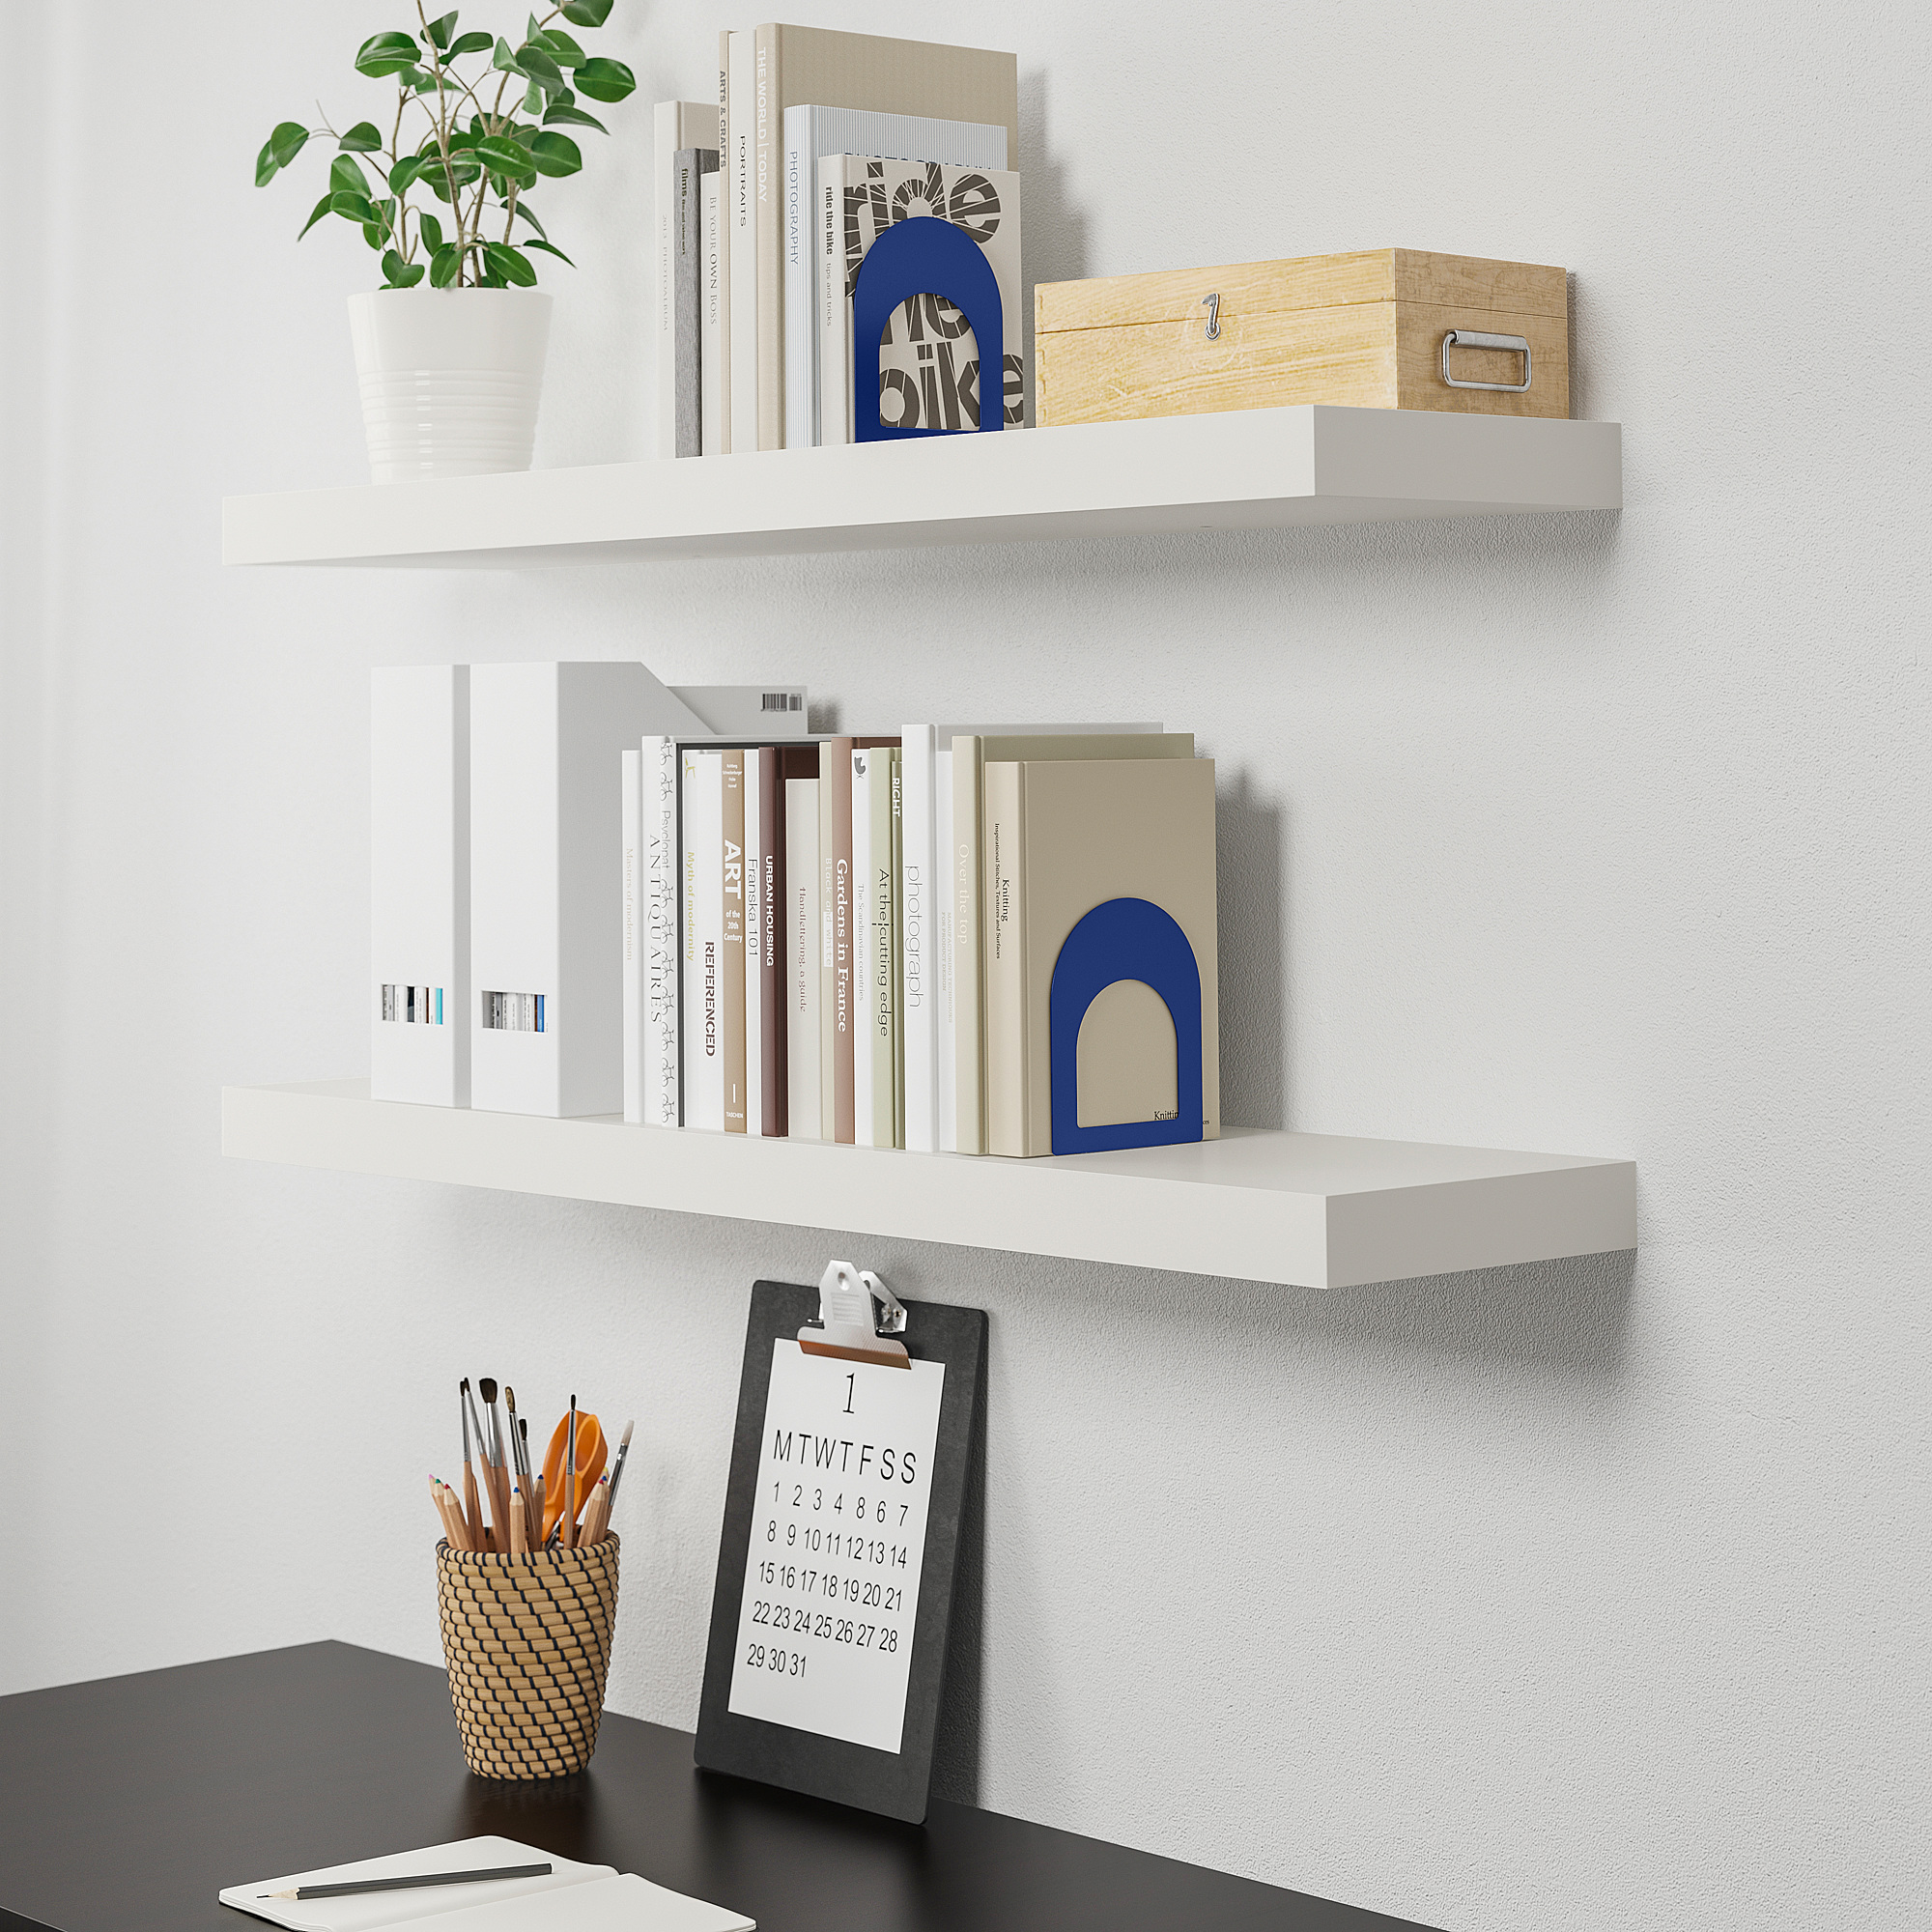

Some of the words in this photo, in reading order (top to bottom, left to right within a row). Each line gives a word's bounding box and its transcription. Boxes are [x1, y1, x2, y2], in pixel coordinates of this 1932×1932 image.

[757, 46, 766, 77] THE
[720, 107, 726, 116] &
[757, 81, 767, 139] WORLD
[758, 151, 768, 203] TODAY
[825, 186, 834, 209] ride
[789, 151, 799, 265] PHOTOGRAPHY
[826, 211, 835, 229] the
[826, 231, 835, 255] bike
[892, 778, 900, 817] RIGHT
[686, 851, 695, 881] Myth
[724, 839, 741, 899] ART
[765, 855, 774, 901] URBAN
[878, 868, 890, 889] At
[959, 843, 970, 883] Over
[627, 891, 634, 901] of
[687, 885, 696, 897] of
[748, 858, 758, 922] Franska
[837, 858, 848, 938] Gardens
[879, 894, 891, 921] the
[959, 889, 969, 916] the
[1001, 878, 1009, 923] Knitting
[648, 834, 662, 1023] ANTIQUAIRES
[686, 900, 696, 962] modernity
[724, 932, 742, 943] Century
[749, 928, 758, 956] 101
[766, 905, 775, 967] HOUSING
[905, 866, 924, 1008] photograph
[958, 921, 968, 945] top
[838, 942, 849, 961] in
[877, 926, 891, 987] cutting
[705, 941, 716, 1057] REFERENCED
[799, 980, 808, 1012] guide
[838, 966, 849, 1033] France
[878, 991, 892, 1037] edge
[1154, 1109, 1179, 1121] Knittin
[842, 1373, 855, 1414] 1
[773, 1429, 793, 1463] M
[798, 1433, 812, 1464] T
[815, 1435, 837, 1469] W
[839, 1440, 854, 1472] T
[859, 1444, 874, 1476] F
[880, 1448, 895, 1481] S
[900, 1452, 917, 1485] S
[774, 1481, 780, 1502] 1
[792, 1484, 803, 1507] 2
[812, 1488, 822, 1511] 3
[834, 1492, 843, 1515] 4
[876, 1500, 887, 1523] 6
[899, 1504, 909, 1527] 7
[767, 1520, 777, 1543] 8
[786, 1523, 796, 1547] 9
[805, 1527, 821, 1551] 10
[826, 1532, 840, 1555] 11
[846, 1536, 864, 1560] 12
[867, 1540, 885, 1565] 13
[890, 1545, 907, 1569] 14
[759, 1560, 776, 1584] 15
[780, 1565, 796, 1589] 16
[801, 1570, 817, 1592] 17
[822, 1574, 838, 1598] 18
[843, 1578, 860, 1603] 19
[862, 1582, 881, 1607] 20
[884, 1586, 902, 1612] 21
[752, 1600, 771, 1625] 22
[772, 1605, 791, 1630] 23
[793, 1609, 810, 1634] 24
[813, 1613, 833, 1639] 25
[835, 1618, 854, 1644] 26
[856, 1623, 876, 1648] 27
[878, 1628, 898, 1653] 28
[747, 1643, 765, 1668] 29
[768, 1648, 786, 1673] 30
[789, 1653, 807, 1678] 31
